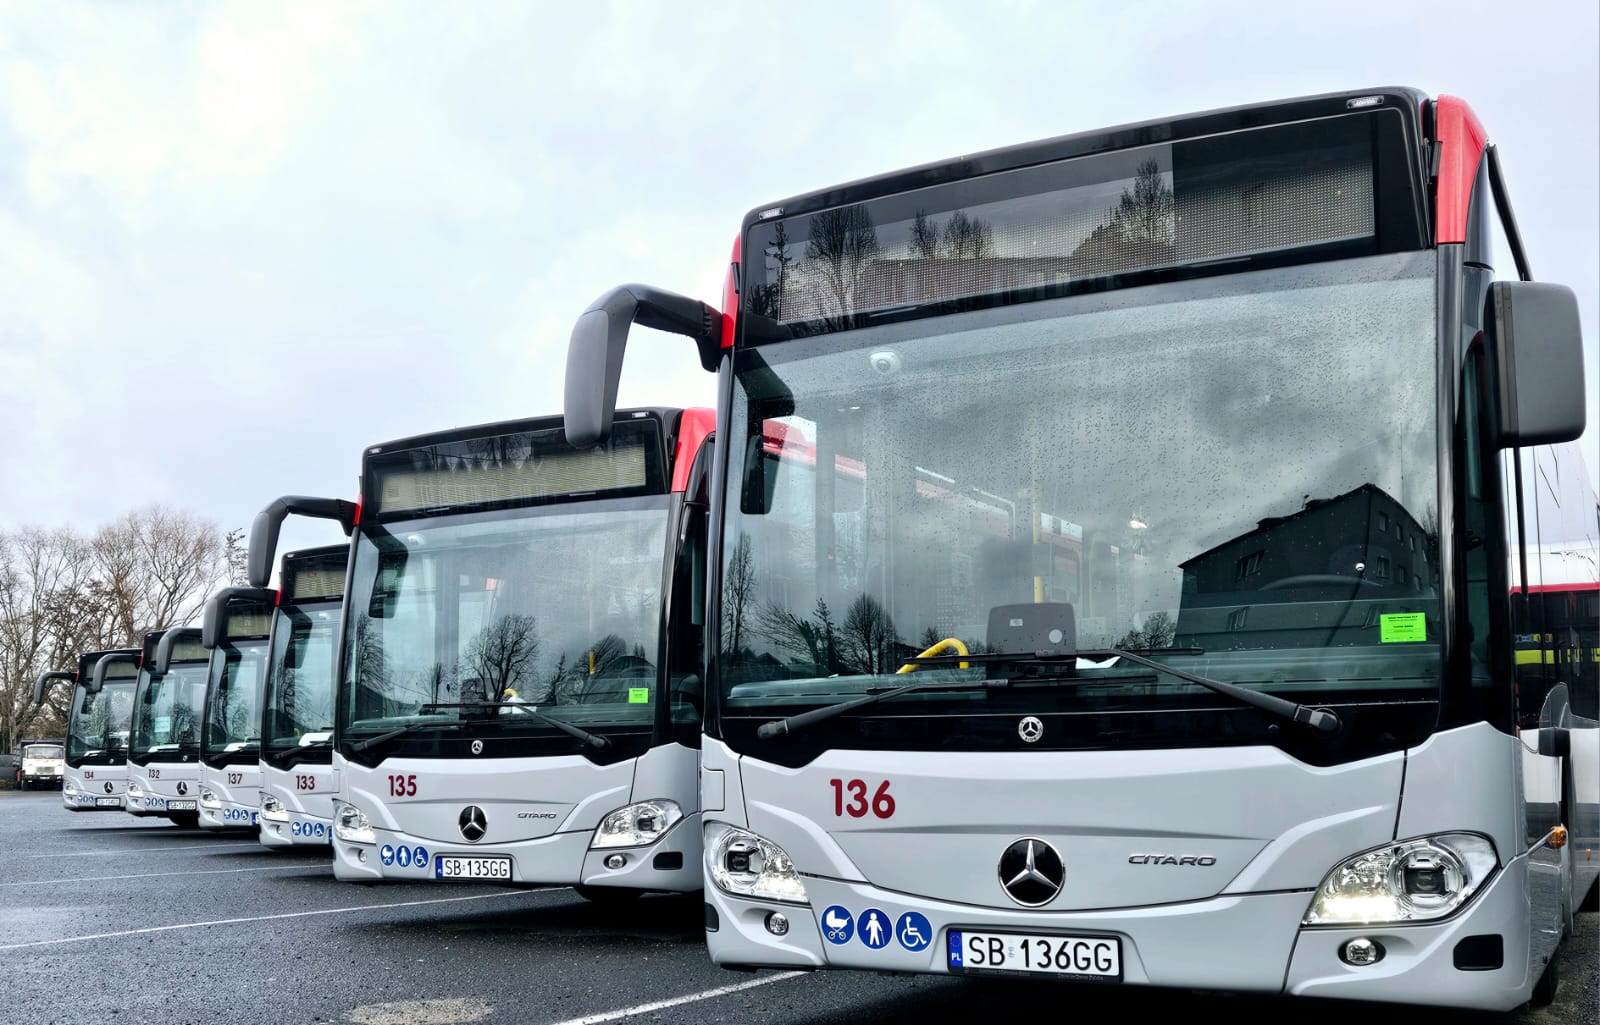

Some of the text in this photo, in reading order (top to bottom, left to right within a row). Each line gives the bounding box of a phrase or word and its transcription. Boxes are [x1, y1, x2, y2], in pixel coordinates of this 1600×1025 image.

[148, 769, 160, 779] 132
[227, 773, 243, 784] 137
[296, 775, 315, 790] 133
[388, 775, 417, 797] 135
[830, 779, 895, 819] 136
[1128, 853, 1216, 866] CITARO
[445, 859, 508, 877] SB 135GG
[951, 953, 961, 961] PL
[969, 936, 1112, 972] SB 136GG
